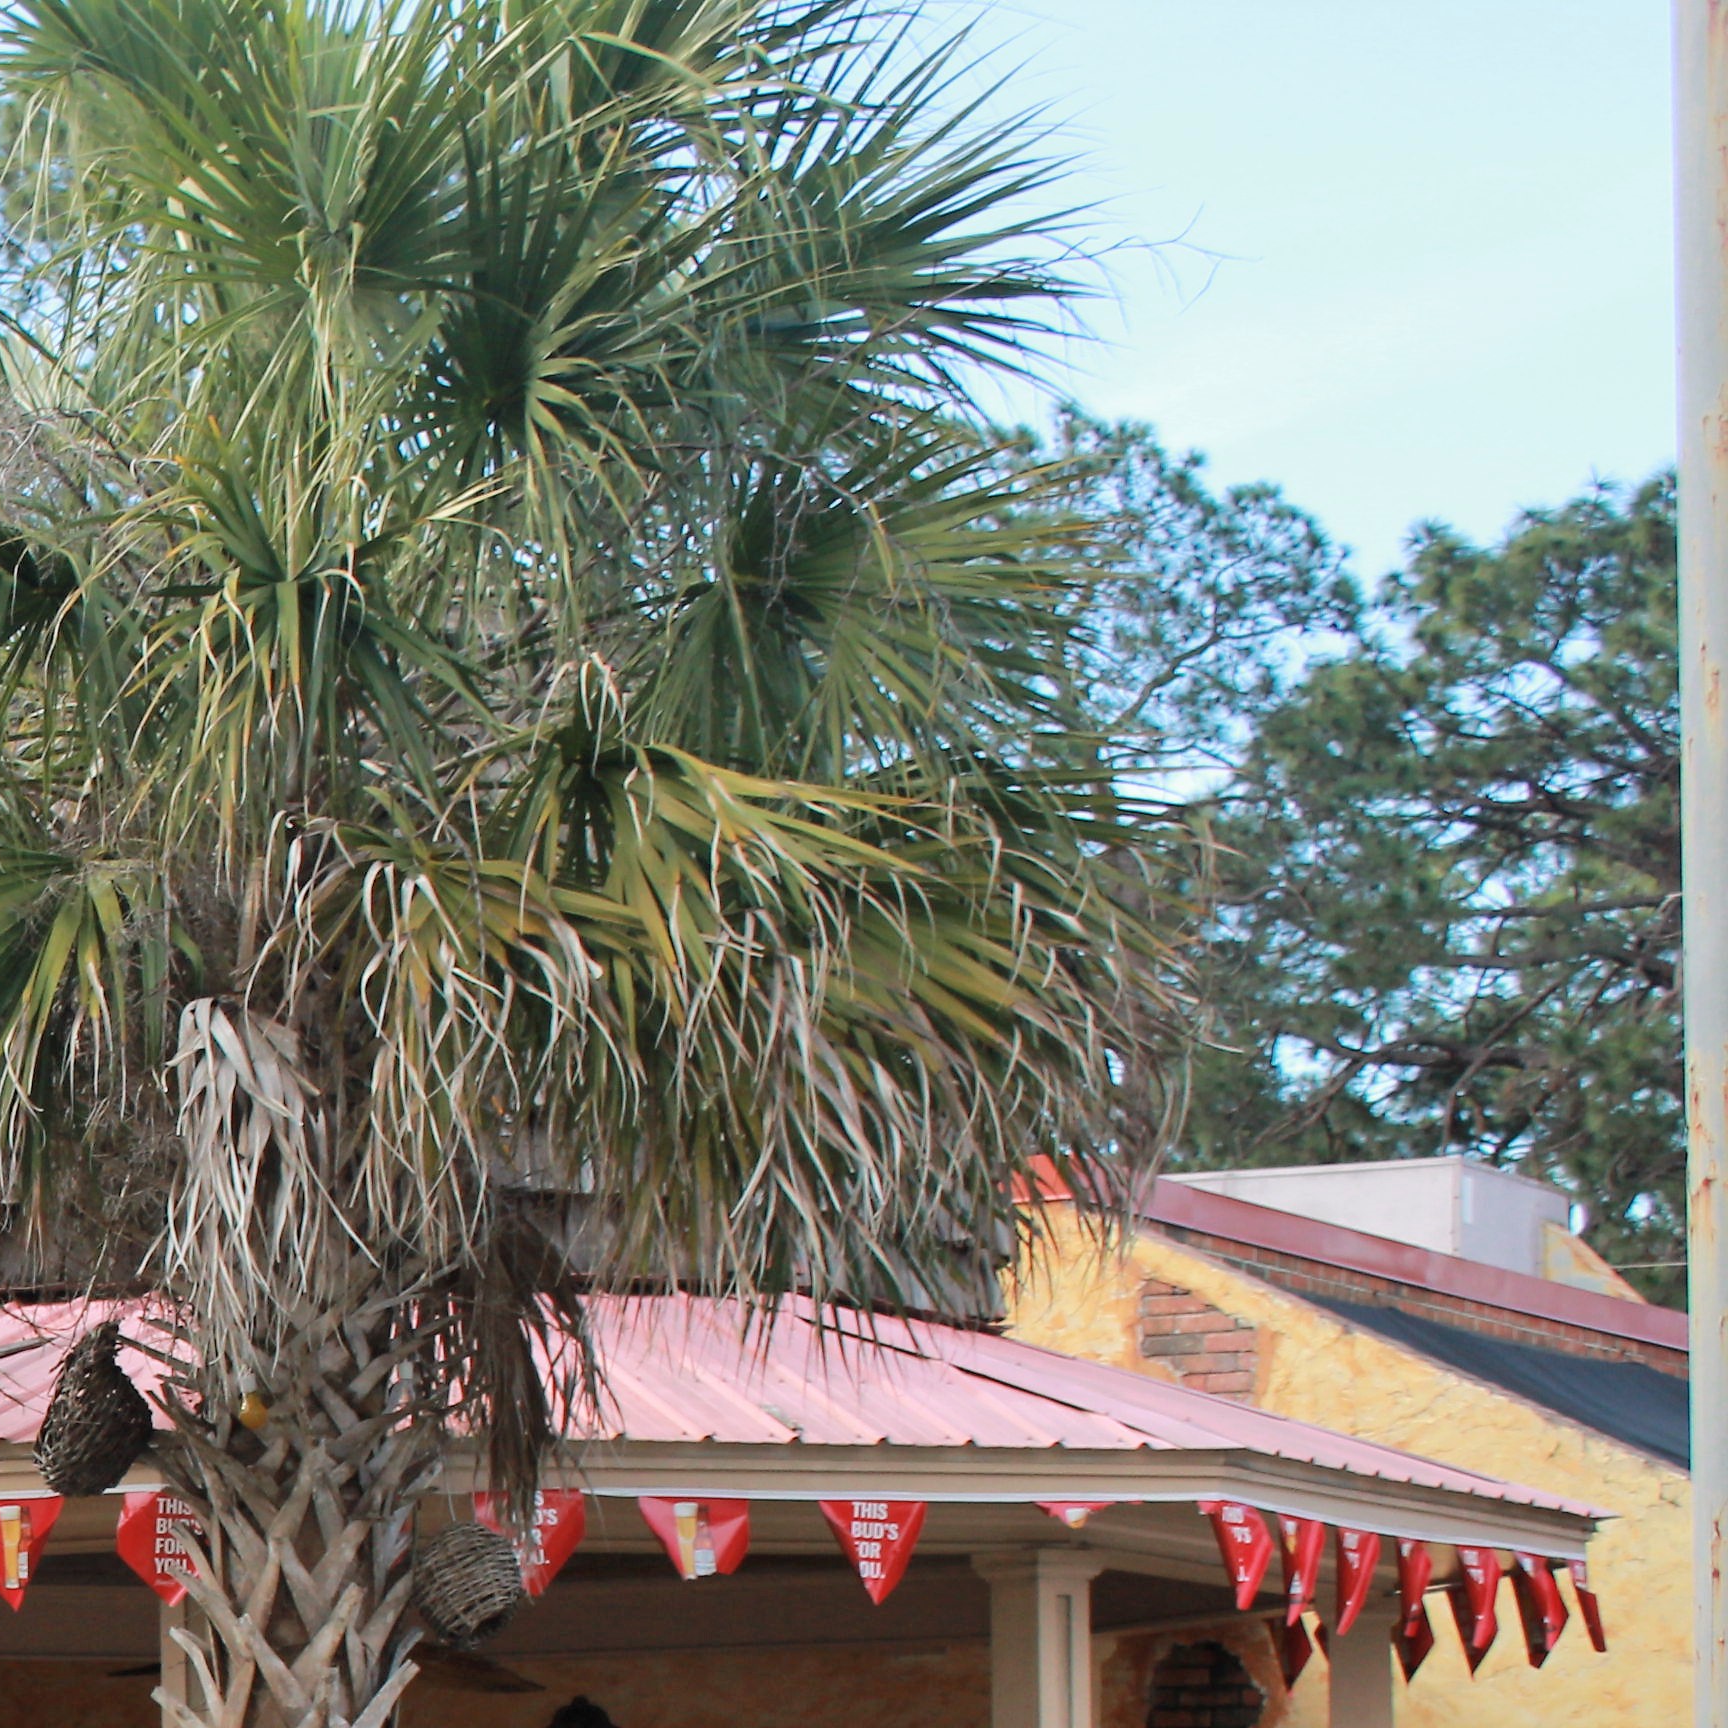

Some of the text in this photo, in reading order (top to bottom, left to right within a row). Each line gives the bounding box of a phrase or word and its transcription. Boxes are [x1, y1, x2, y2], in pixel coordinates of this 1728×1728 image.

[852, 1501, 889, 1520] THIS
[851, 1521, 899, 1541] BUD'S
[859, 1561, 885, 1579] OU.
